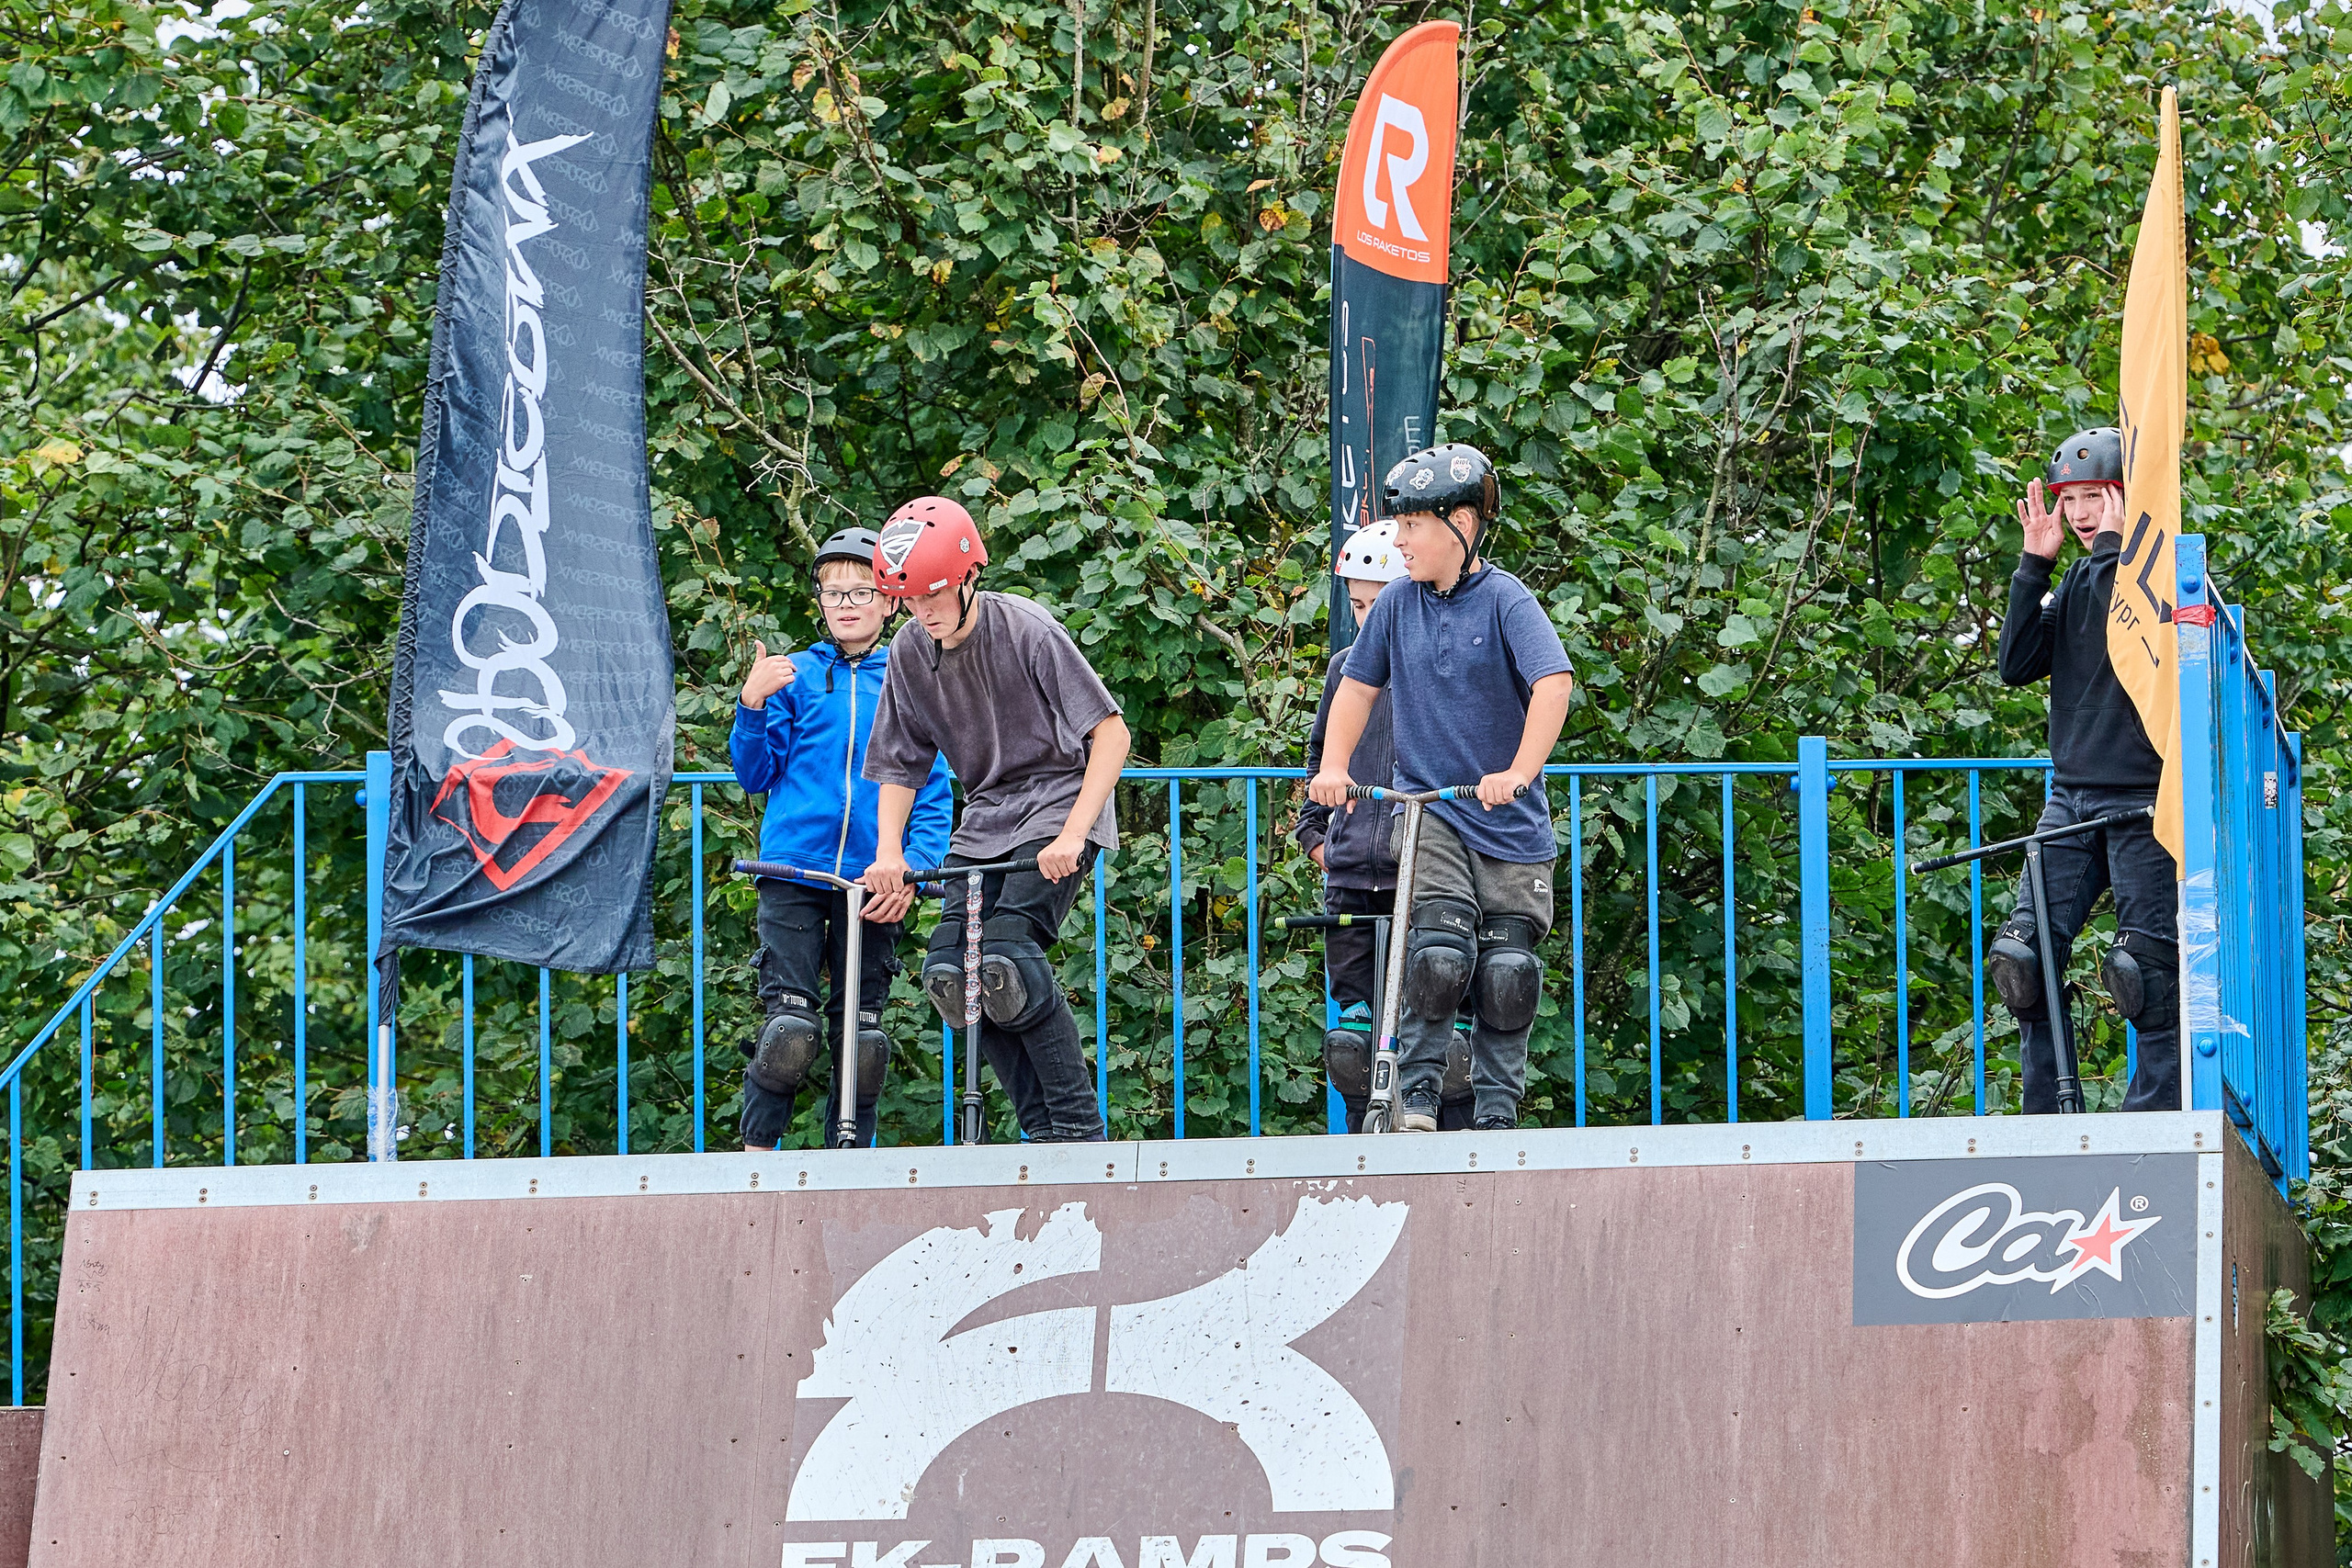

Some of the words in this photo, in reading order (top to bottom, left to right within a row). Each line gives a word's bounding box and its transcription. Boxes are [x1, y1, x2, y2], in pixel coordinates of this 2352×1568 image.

[1356, 229, 1373, 246] LOS
[1373, 236, 1430, 263] RAKETOS
[790, 995, 808, 1008] TOTEM
[859, 1011, 877, 1023] TOTEM
